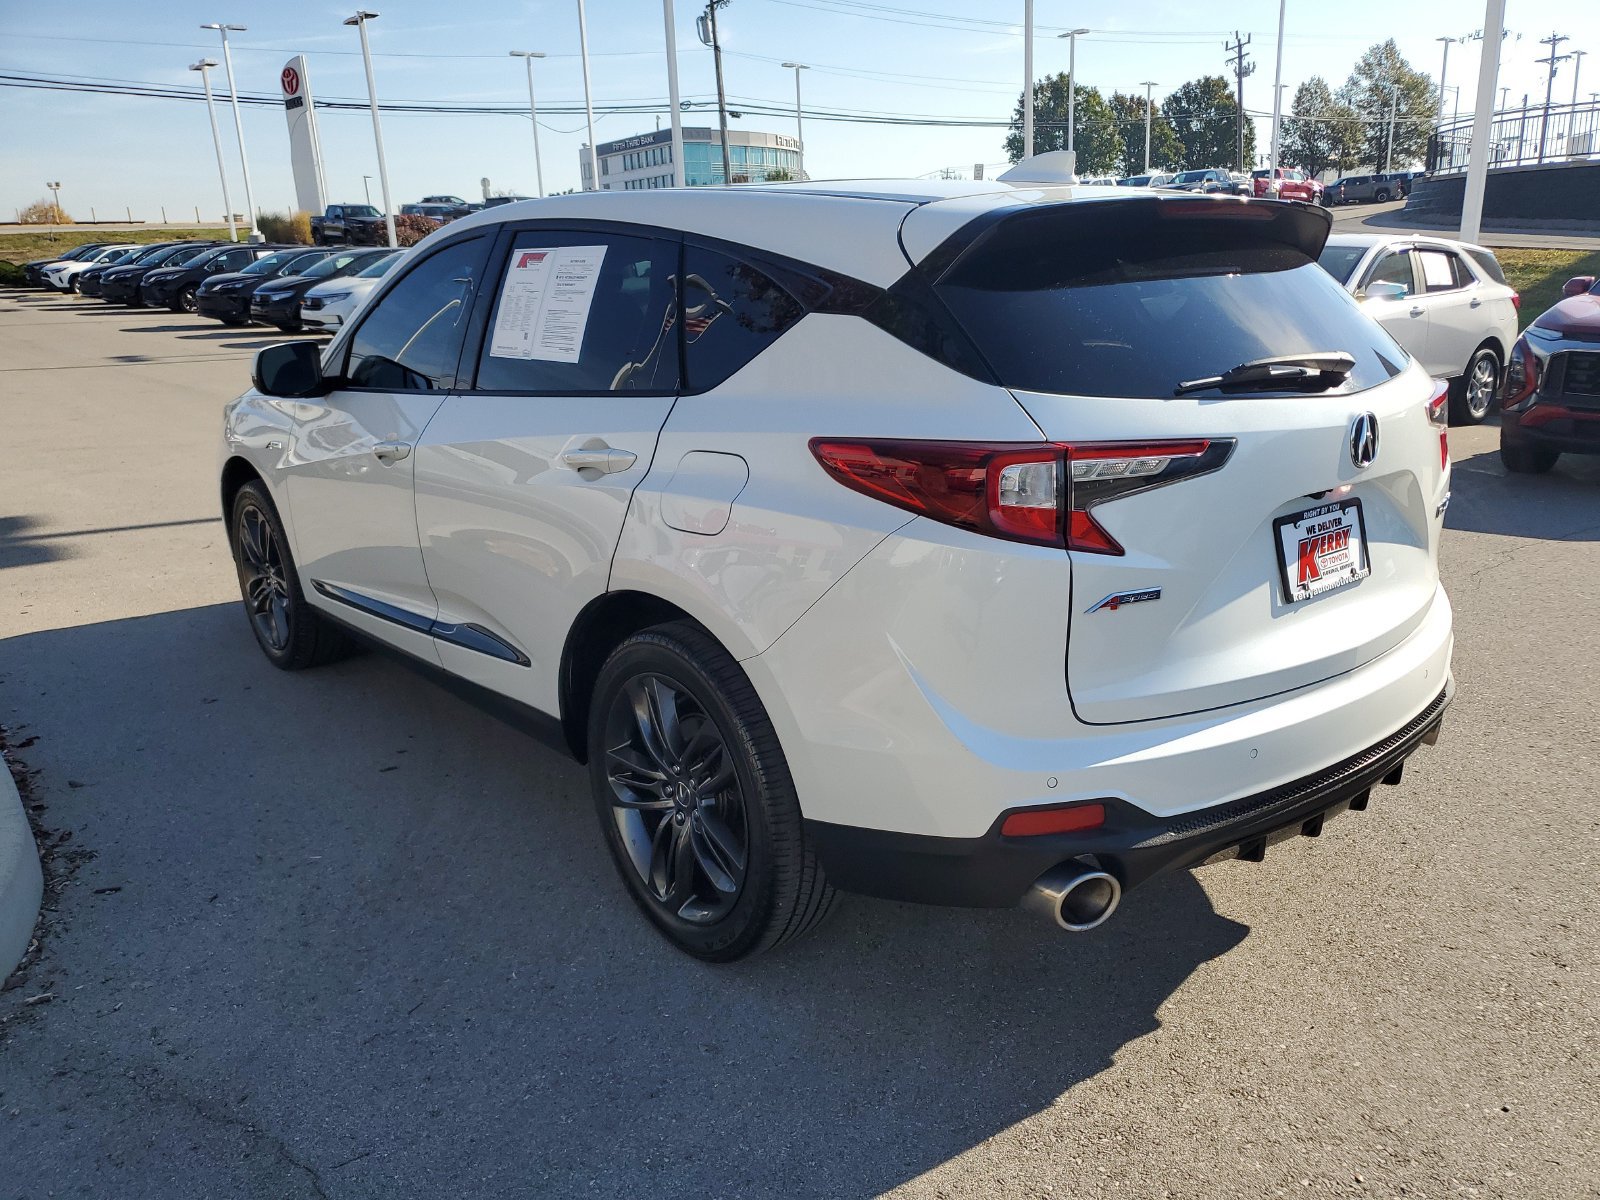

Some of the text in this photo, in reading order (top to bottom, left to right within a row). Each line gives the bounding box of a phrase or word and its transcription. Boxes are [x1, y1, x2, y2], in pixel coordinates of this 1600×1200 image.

[612, 136, 654, 151] FIFTH THIRD BANK
[1303, 503, 1340, 519] RIGHT BY YOU
[1306, 517, 1343, 536] WE DELIVER
[1298, 528, 1351, 584] KERRY
[1328, 552, 1348, 564] TOYOTA
[1294, 570, 1370, 601] kerryautomotive.com
